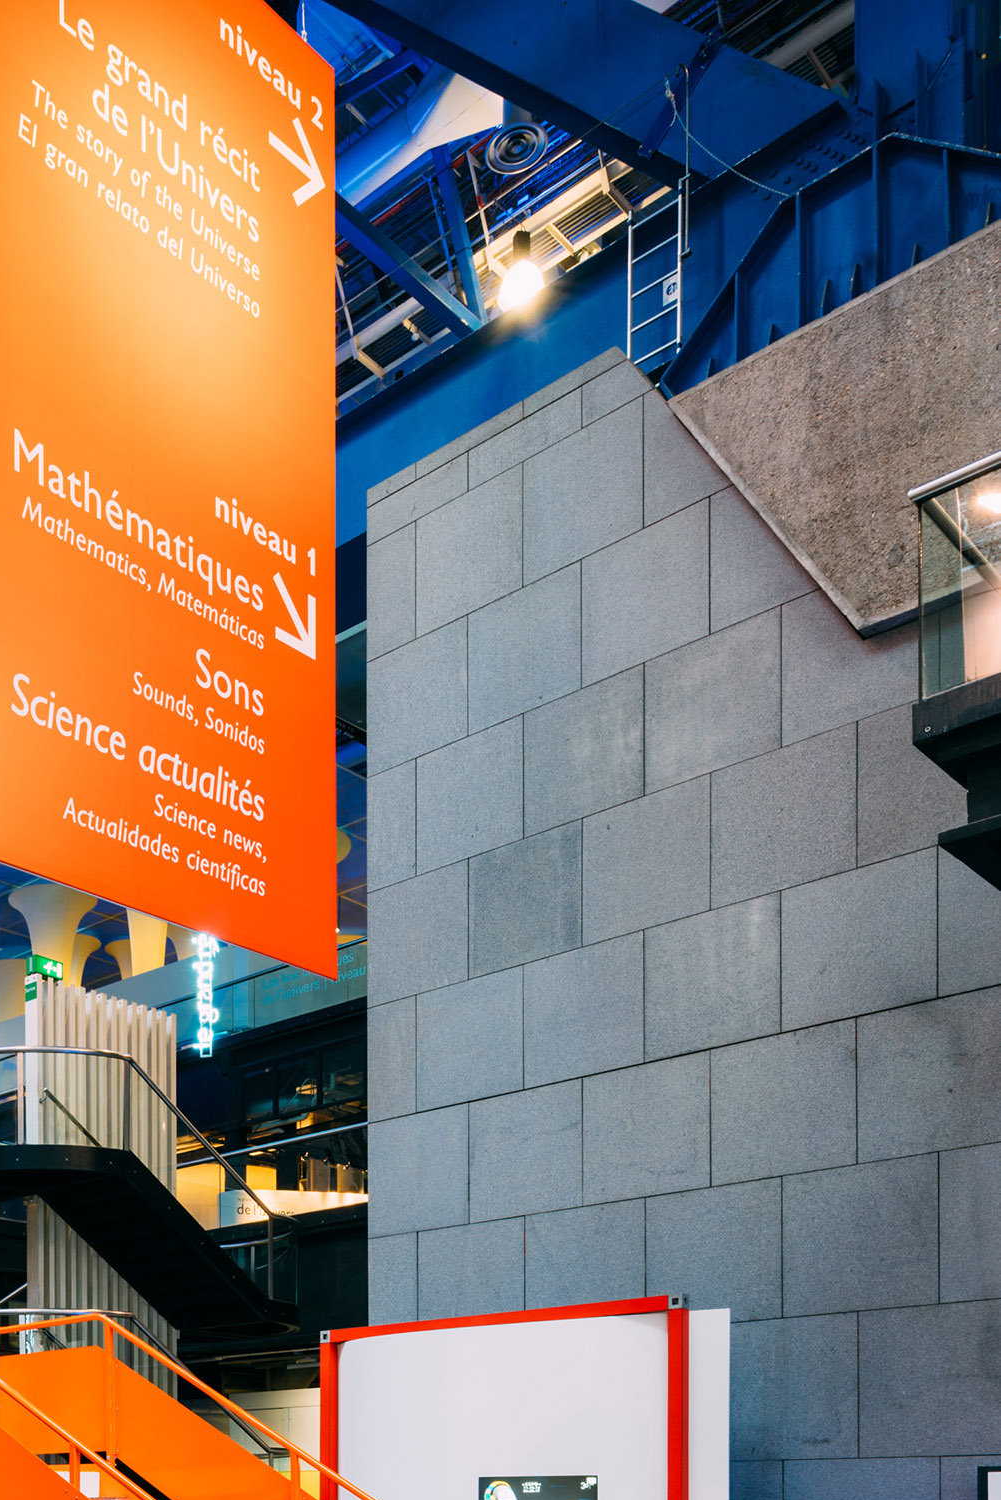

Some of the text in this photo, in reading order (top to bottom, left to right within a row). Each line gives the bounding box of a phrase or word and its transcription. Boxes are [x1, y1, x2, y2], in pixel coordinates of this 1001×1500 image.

[59, 0, 261, 193] Le grand récit
[220, 18, 324, 131] niveau 2
[18, 113, 260, 318] El gran relato del Universo
[31, 79, 260, 281] The story of the Universe
[92, 83, 260, 243] de l'Univers
[14, 428, 264, 611] Mathématiques
[21, 496, 264, 650] Mathematics, Matemáticas
[215, 496, 316, 576] niveau 1
[11, 673, 265, 821] Science actualités
[133, 671, 265, 754] Sounds, Sonidos
[196, 648, 264, 716] Sons
[62, 797, 265, 897] Actualidades científicas
[154, 793, 268, 863] Science news,
[330, 966, 367, 984] iveau
